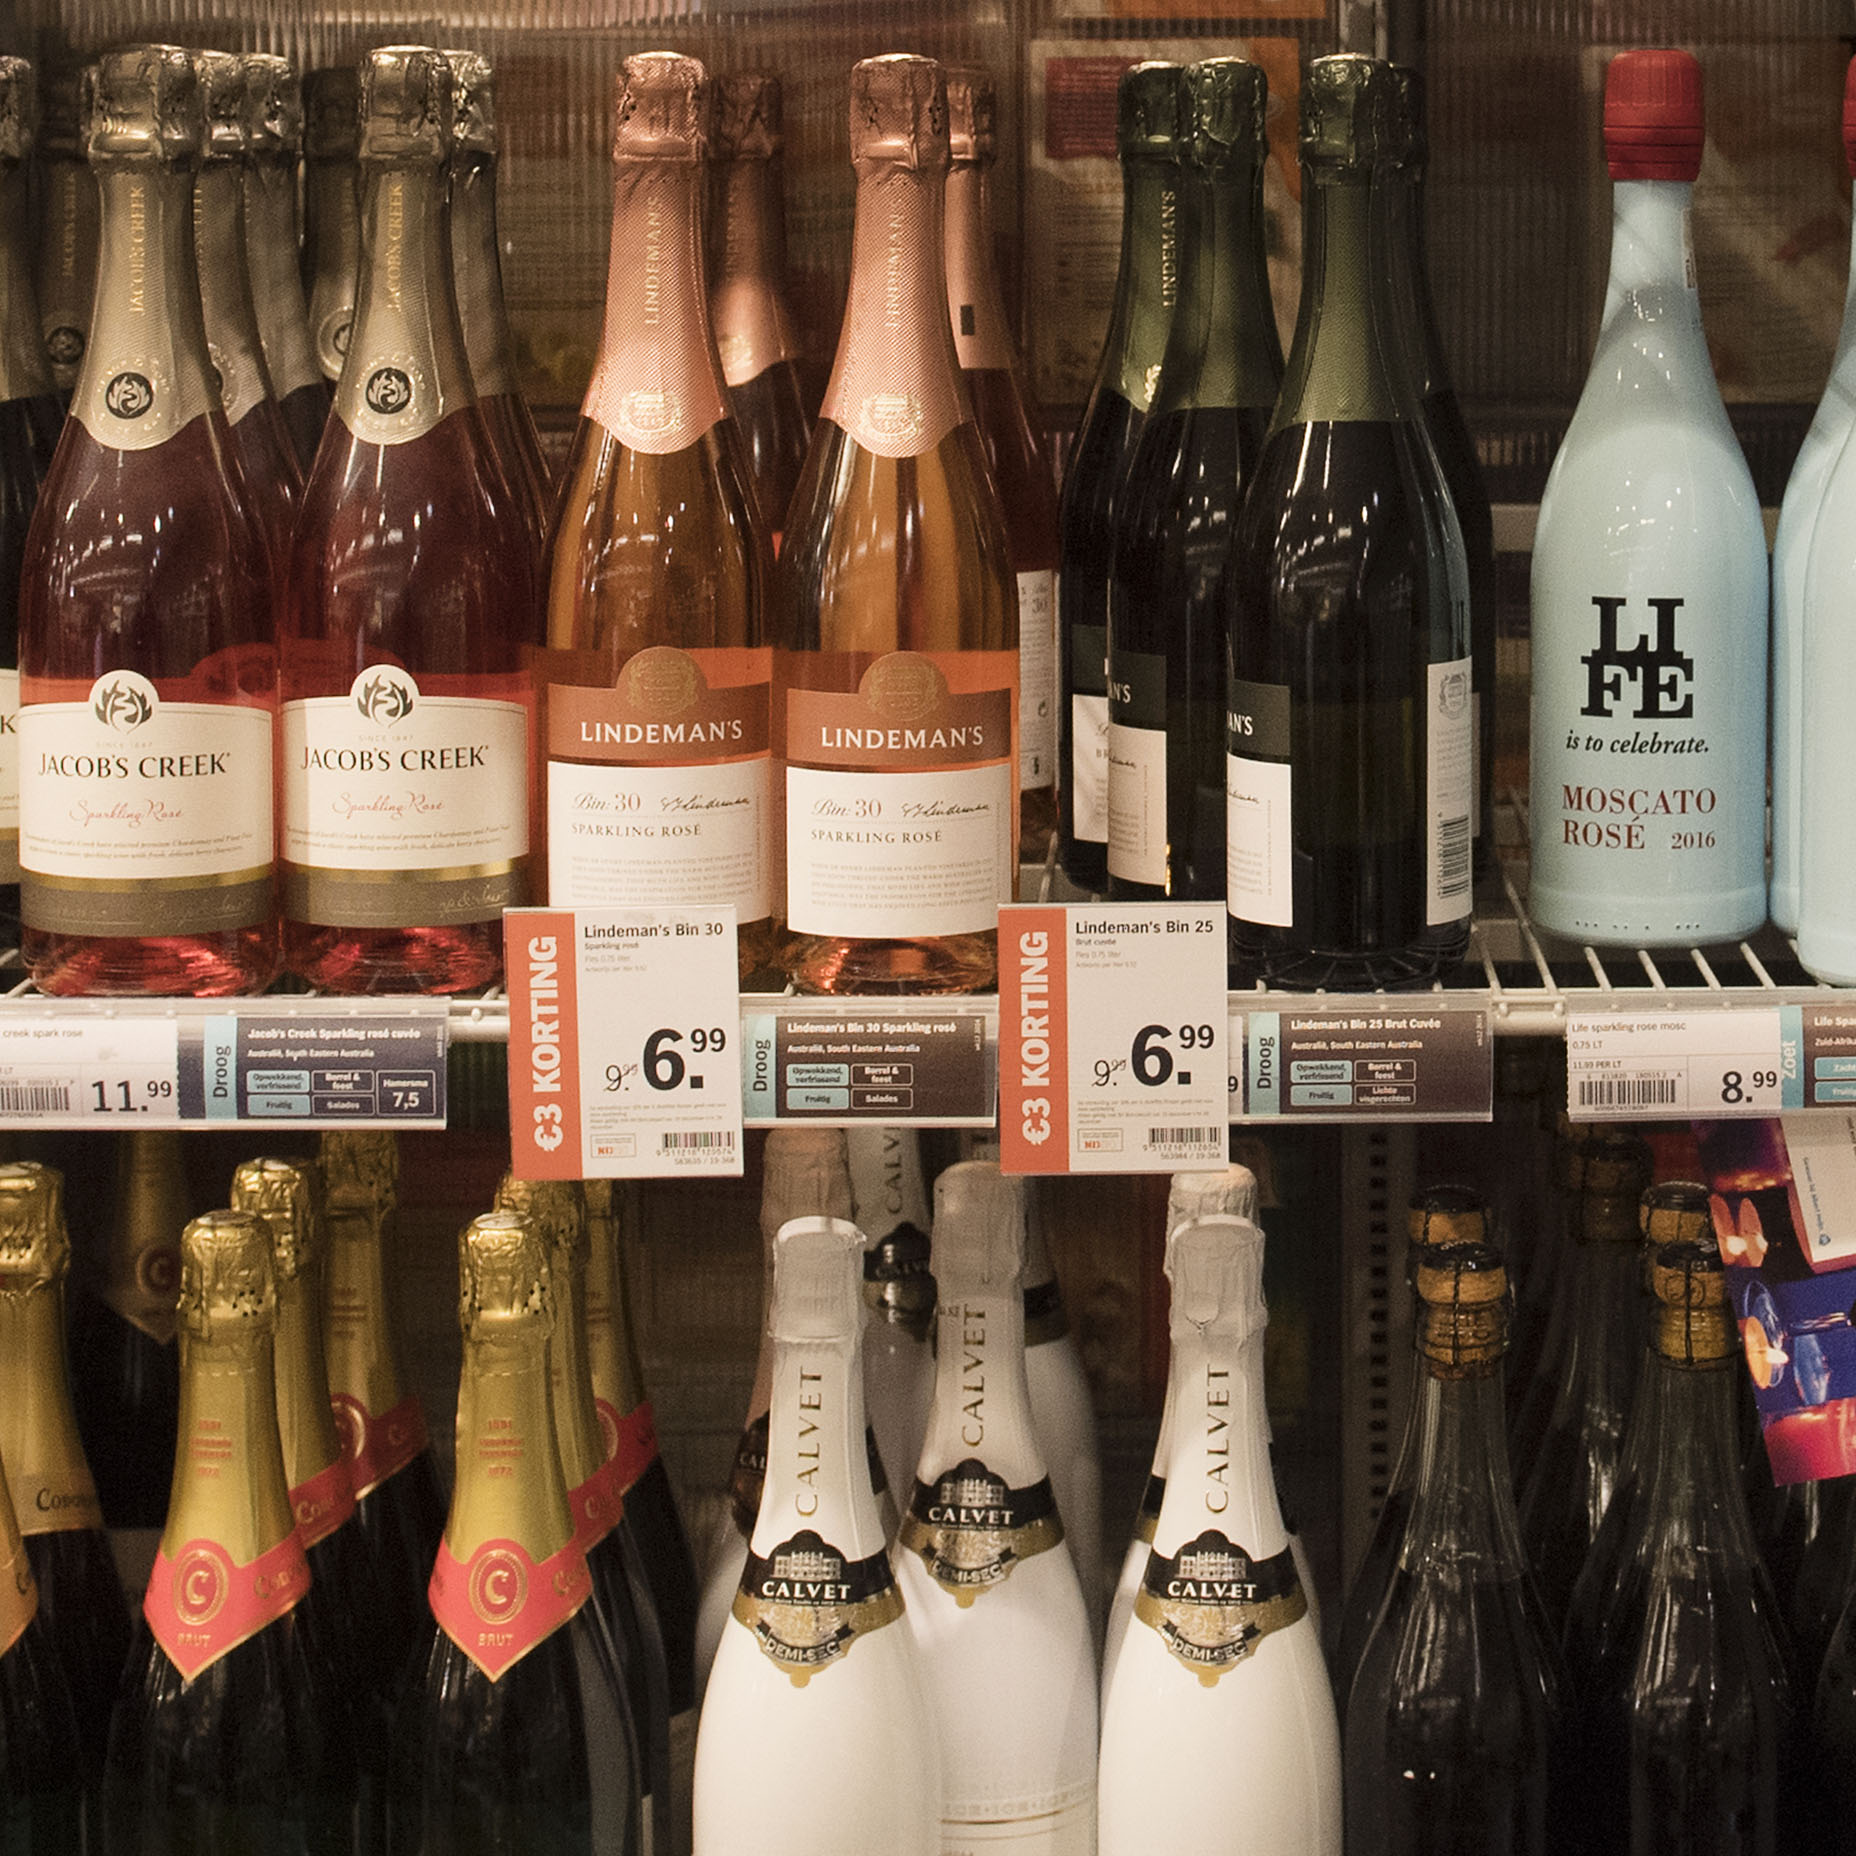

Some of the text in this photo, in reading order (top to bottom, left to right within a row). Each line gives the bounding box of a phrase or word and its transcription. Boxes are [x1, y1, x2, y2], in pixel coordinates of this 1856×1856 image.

[580, 719, 742, 744] LINDEMAN'S
[821, 726, 984, 750] LINDEMAN'S
[1567, 730, 1710, 754] is to celebrate.
[38, 752, 227, 778] JACOB'S CREEK
[301, 746, 487, 773] JACOB'S CREEK
[614, 792, 641, 811] 30
[1562, 785, 1717, 815] MOSCATO
[571, 822, 702, 839] SPARKLING ROSÉ
[1564, 816, 1716, 850] ROSÉ 2016
[584, 923, 723, 939] Lindeman's Bin 30
[1075, 920, 1213, 937] Lindeman's Bin 25
[528, 935, 564, 1152] €3 KORTING
[1019, 930, 1051, 1146] €3 KORTING
[961, 1304, 988, 1448] CALVET
[794, 1365, 823, 1517] CALVET
[1205, 1364, 1230, 1515] CALVET
[928, 1507, 1014, 1527] CALVET
[761, 1580, 850, 1603] CALVET
[1167, 1580, 1255, 1601] CALVET
[477, 1631, 513, 1648] BRUT
